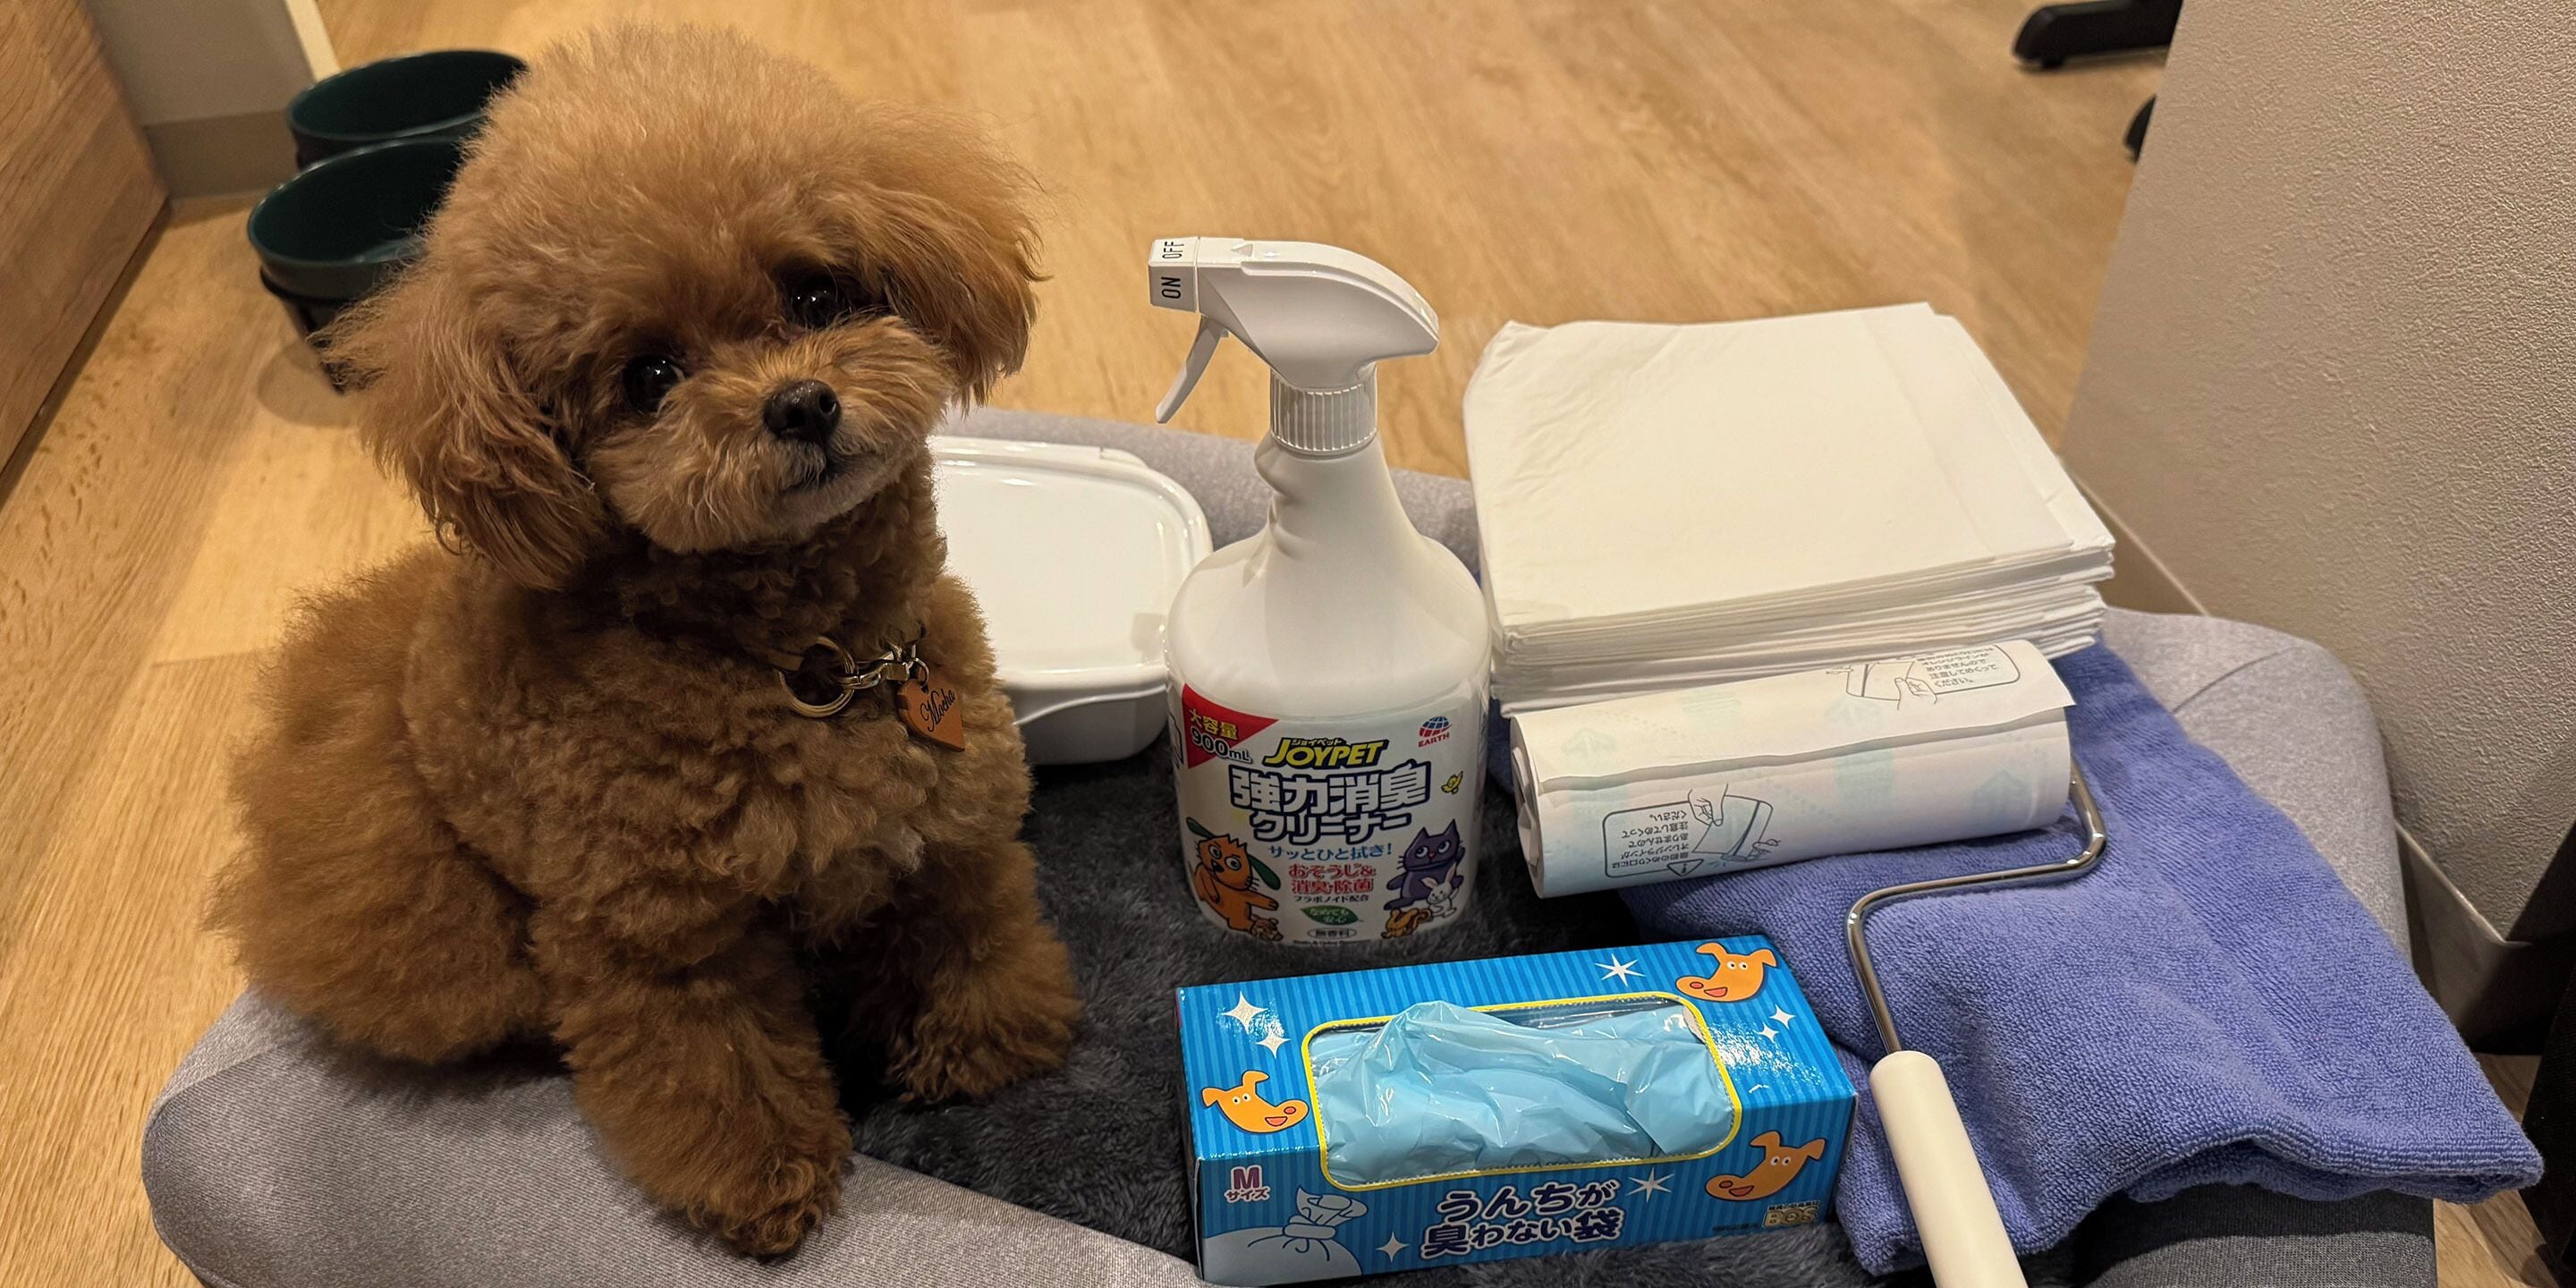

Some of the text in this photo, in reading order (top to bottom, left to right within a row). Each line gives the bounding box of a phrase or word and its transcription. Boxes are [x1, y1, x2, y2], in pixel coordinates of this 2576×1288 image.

[1162, 242, 1184, 259] OFF
[1161, 276, 1182, 299] ON
[919, 688, 955, 733] Mocha
[1189, 708, 1238, 741] 大容量
[1191, 726, 1252, 764] 900mL
[1291, 738, 1343, 747] ジョイペット
[1418, 732, 1450, 748] EARTH
[1263, 738, 1387, 768] JOYPET
[1230, 760, 1430, 815] 強力消臭
[1649, 809, 1688, 822] ください。
[1250, 812, 1411, 845] クリーナー
[1621, 821, 1689, 839] 注意してめくって
[1620, 843, 1690, 860] オレンジラインが
[1628, 833, 1689, 849] ありませんので
[1233, 1166, 1260, 1190] M
[1224, 1188, 1270, 1203] サイズ
[1436, 1179, 1620, 1222] うんちが
[1764, 1207, 1818, 1228] BOS
[1420, 1208, 1623, 1258] 臭わない袋
